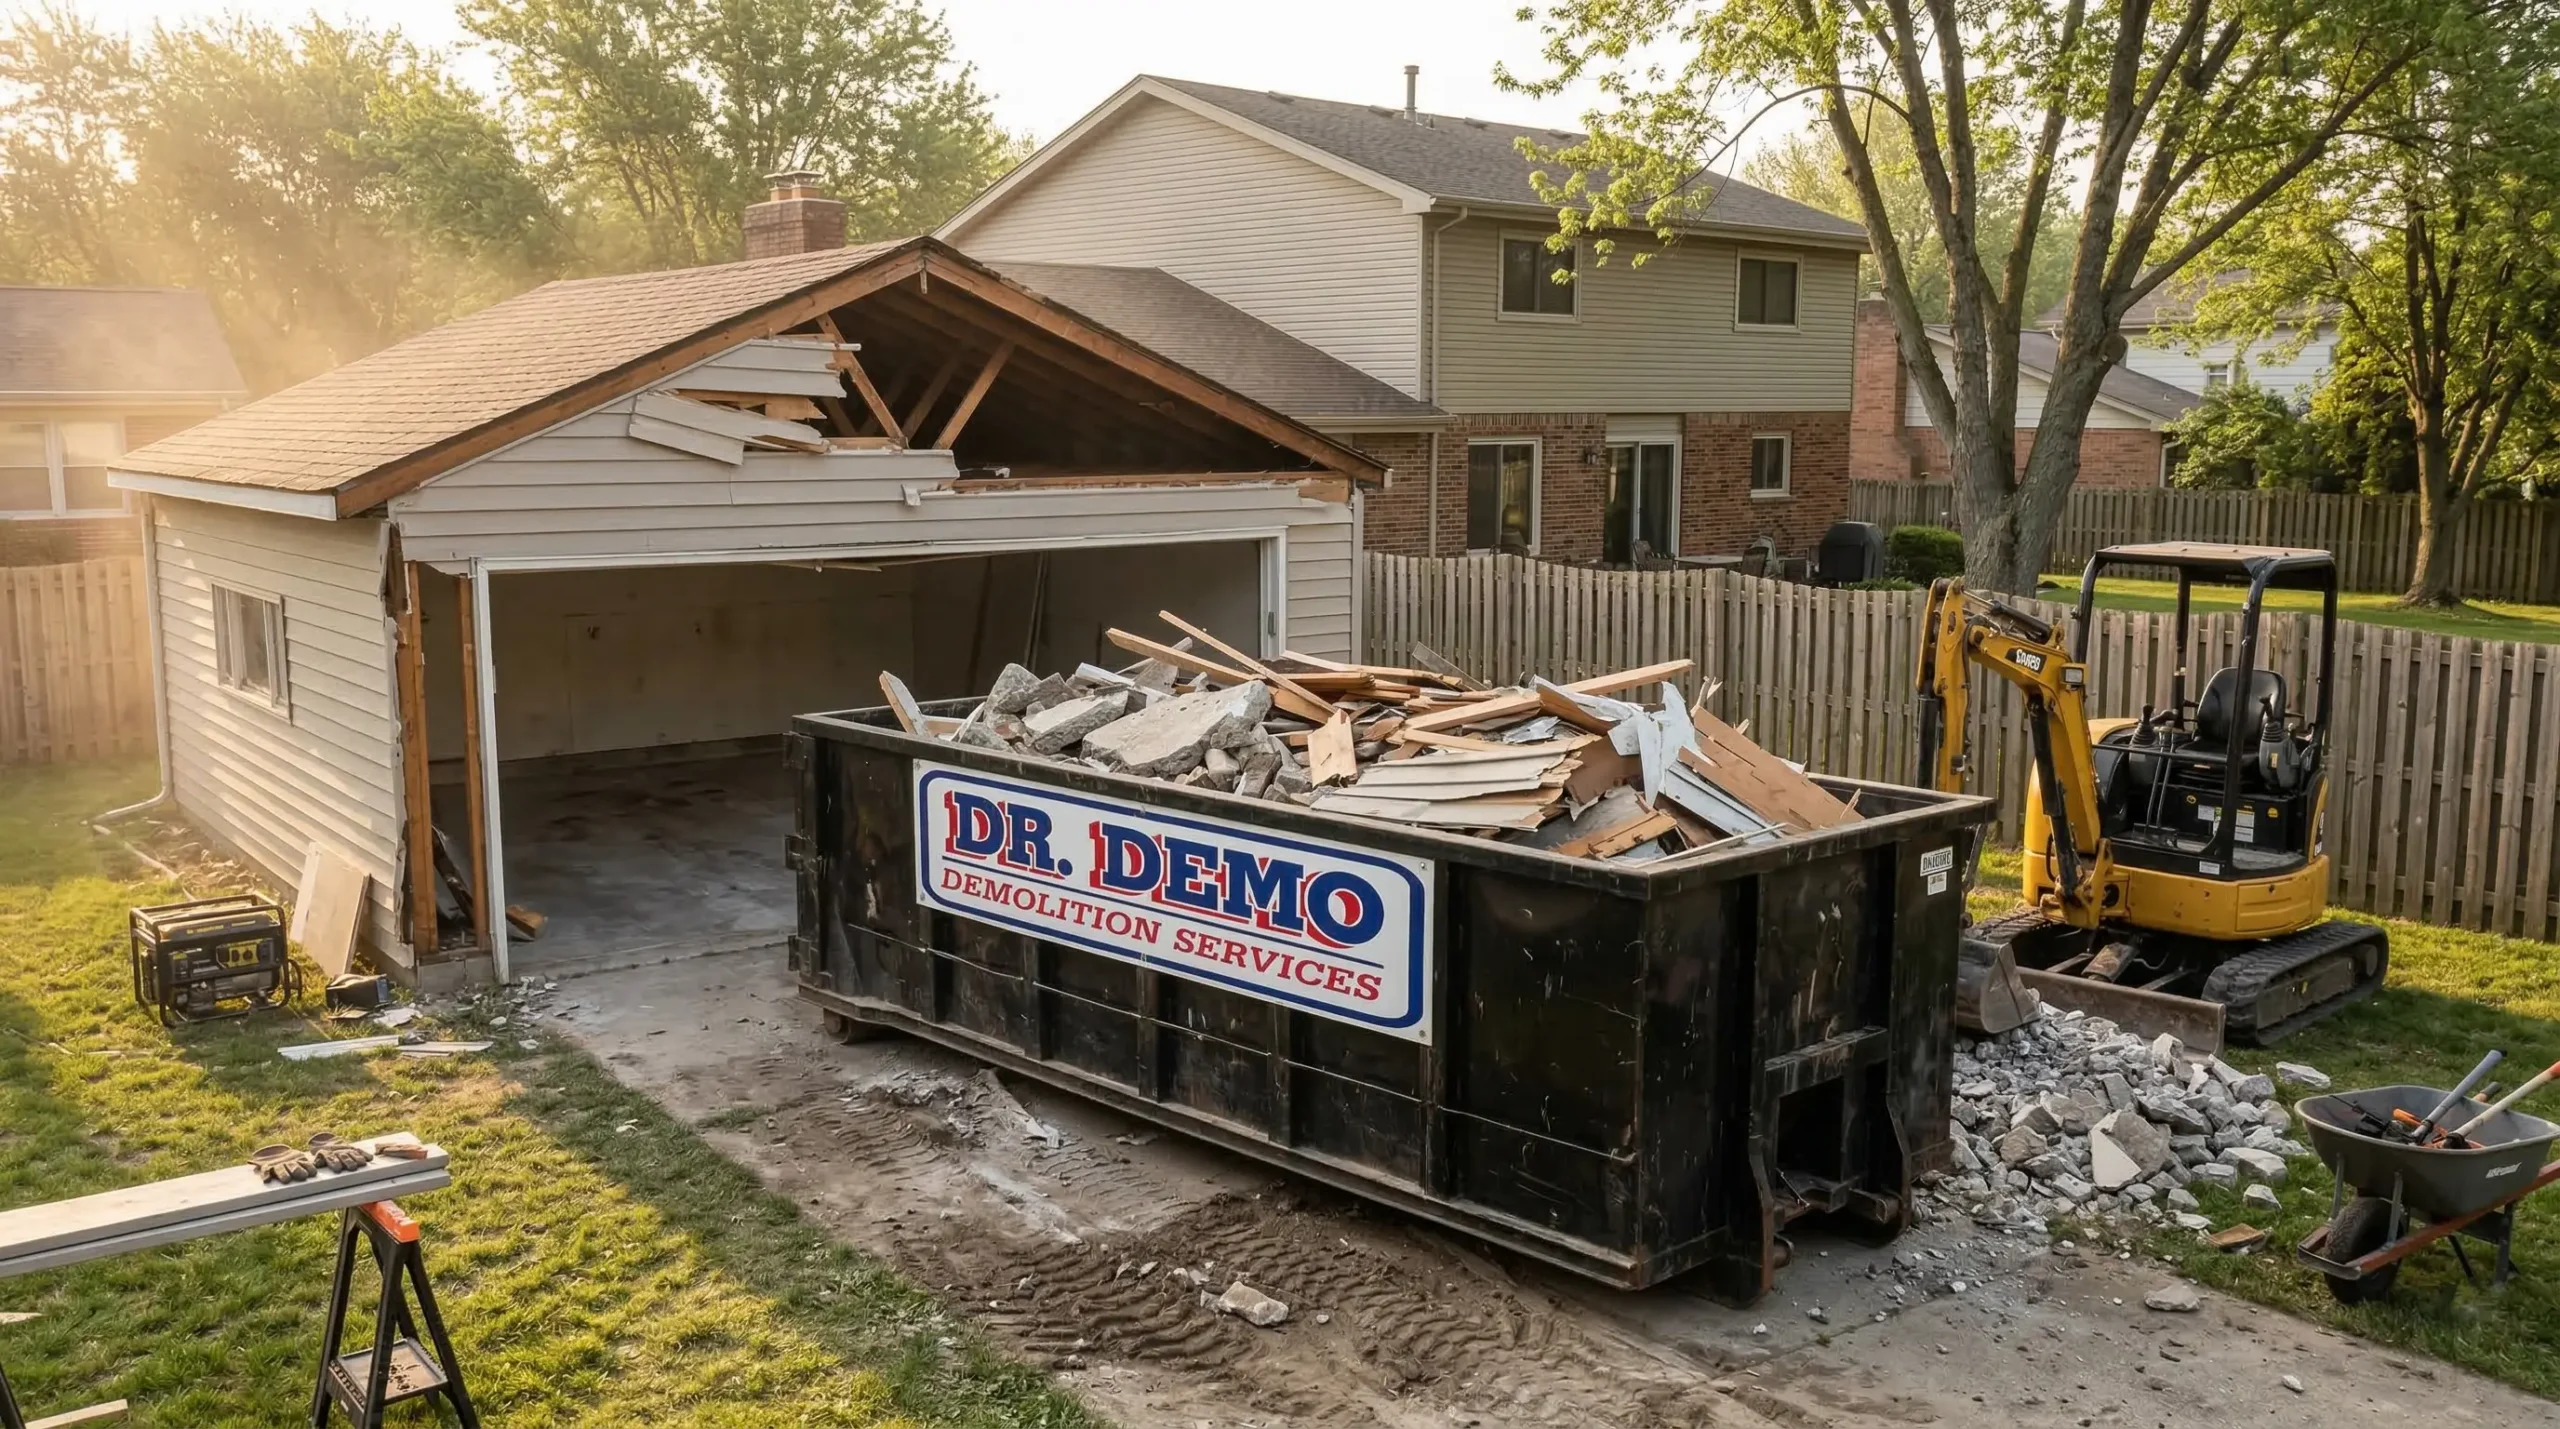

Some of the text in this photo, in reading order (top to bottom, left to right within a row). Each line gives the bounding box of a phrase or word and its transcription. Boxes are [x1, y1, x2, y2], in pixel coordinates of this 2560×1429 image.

[941, 867, 1383, 1001] DEMOLITION SERVICES
[943, 790, 1385, 949] DR. DEMO
